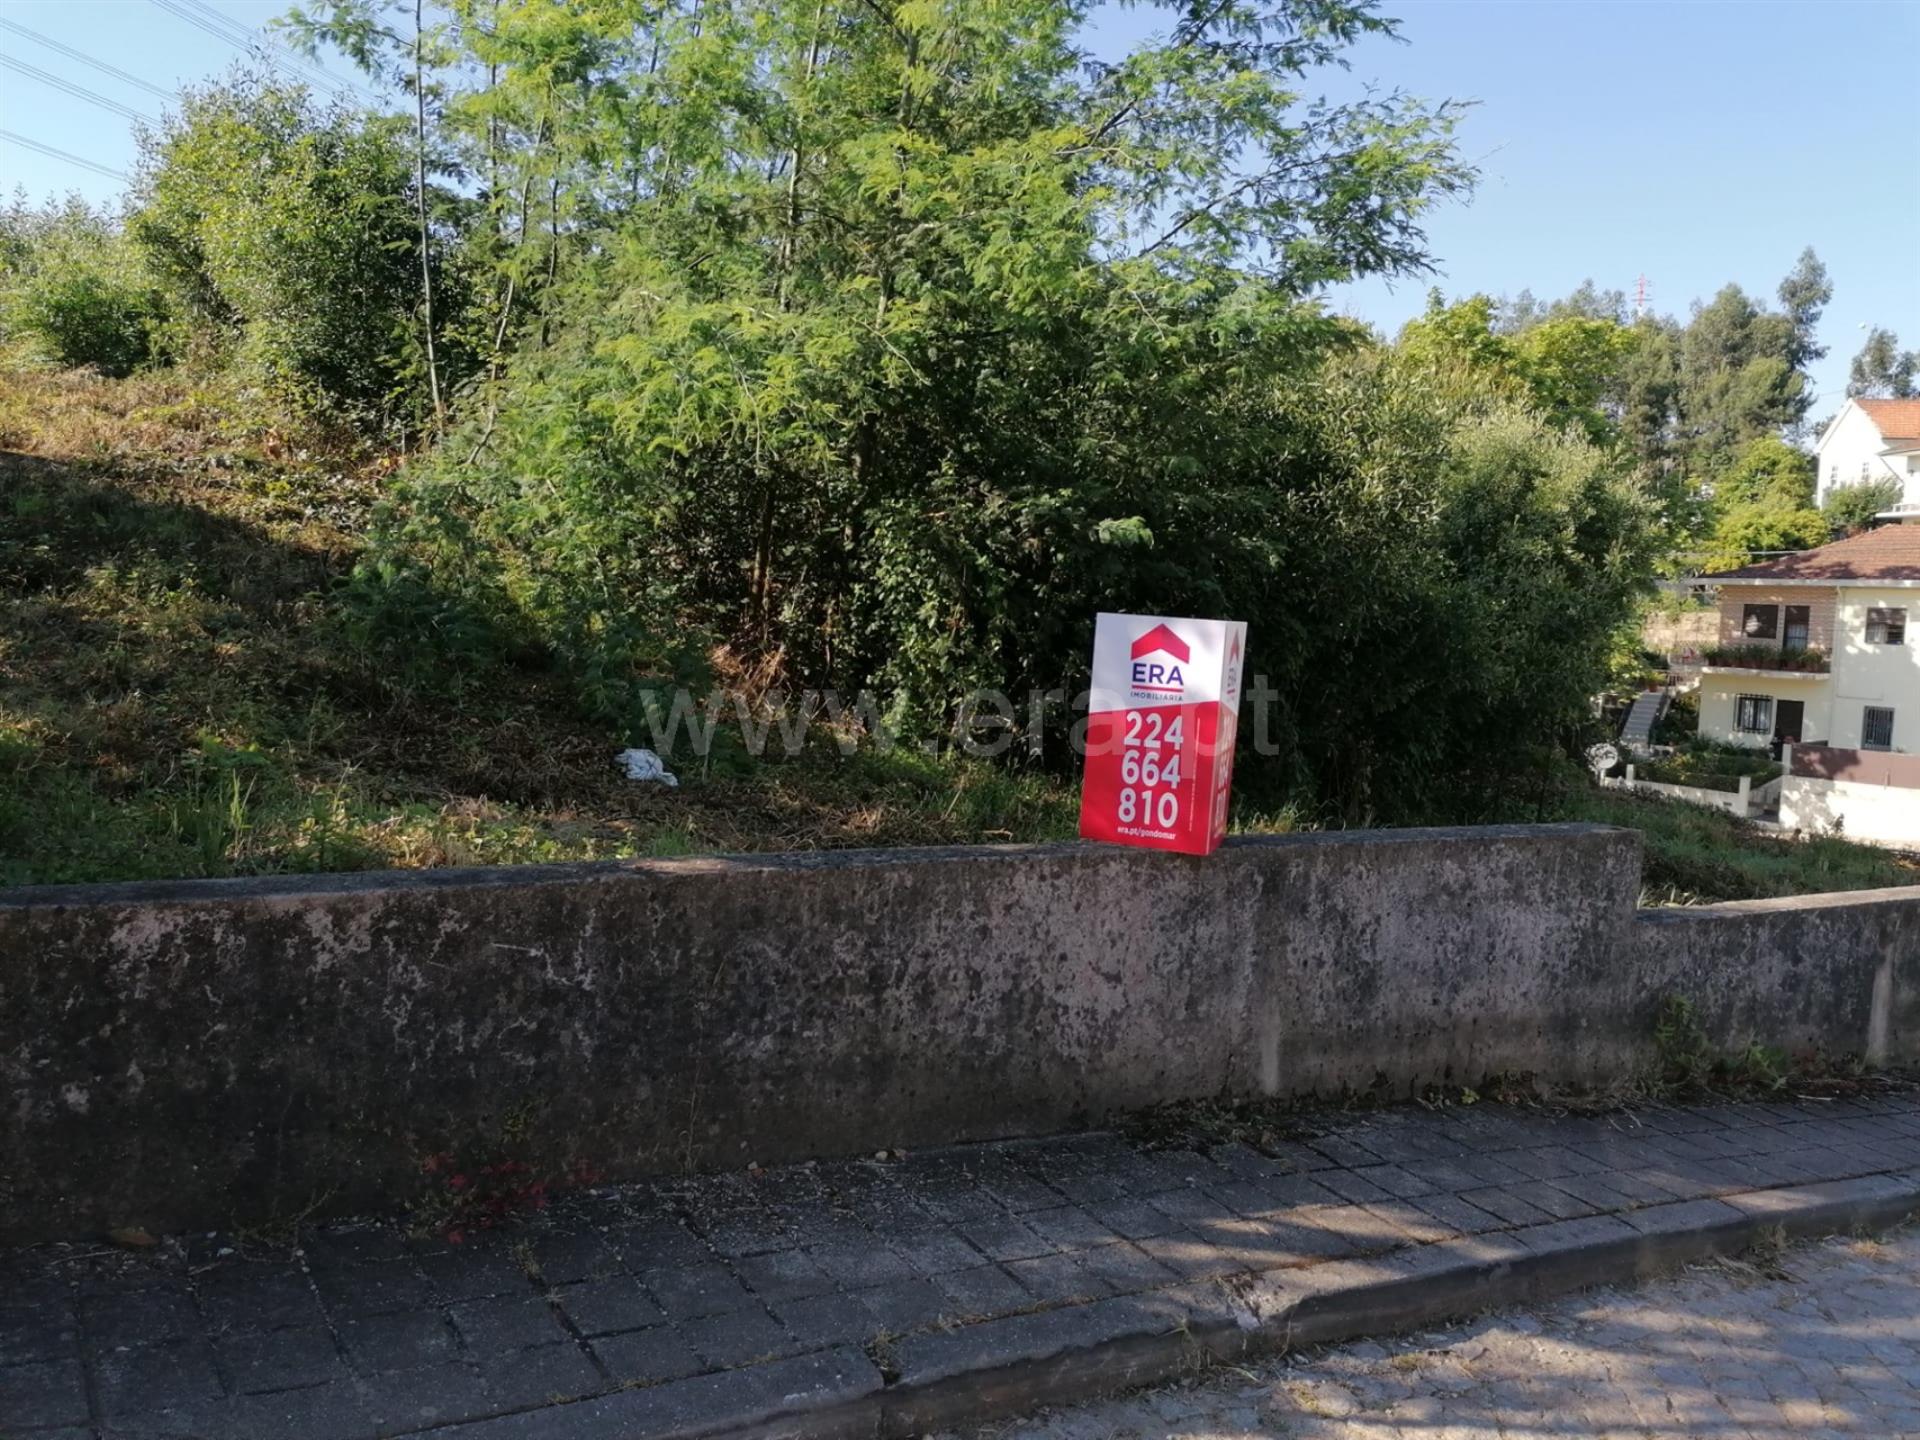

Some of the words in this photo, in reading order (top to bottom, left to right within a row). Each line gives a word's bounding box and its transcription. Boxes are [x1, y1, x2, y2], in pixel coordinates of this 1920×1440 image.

[1132, 662, 1184, 686] ERA
[1123, 711, 1184, 750] 224
[1121, 749, 1181, 789] 664
[1118, 787, 1178, 828] 810
[1117, 826, 1177, 841] era.pt/gondomar
